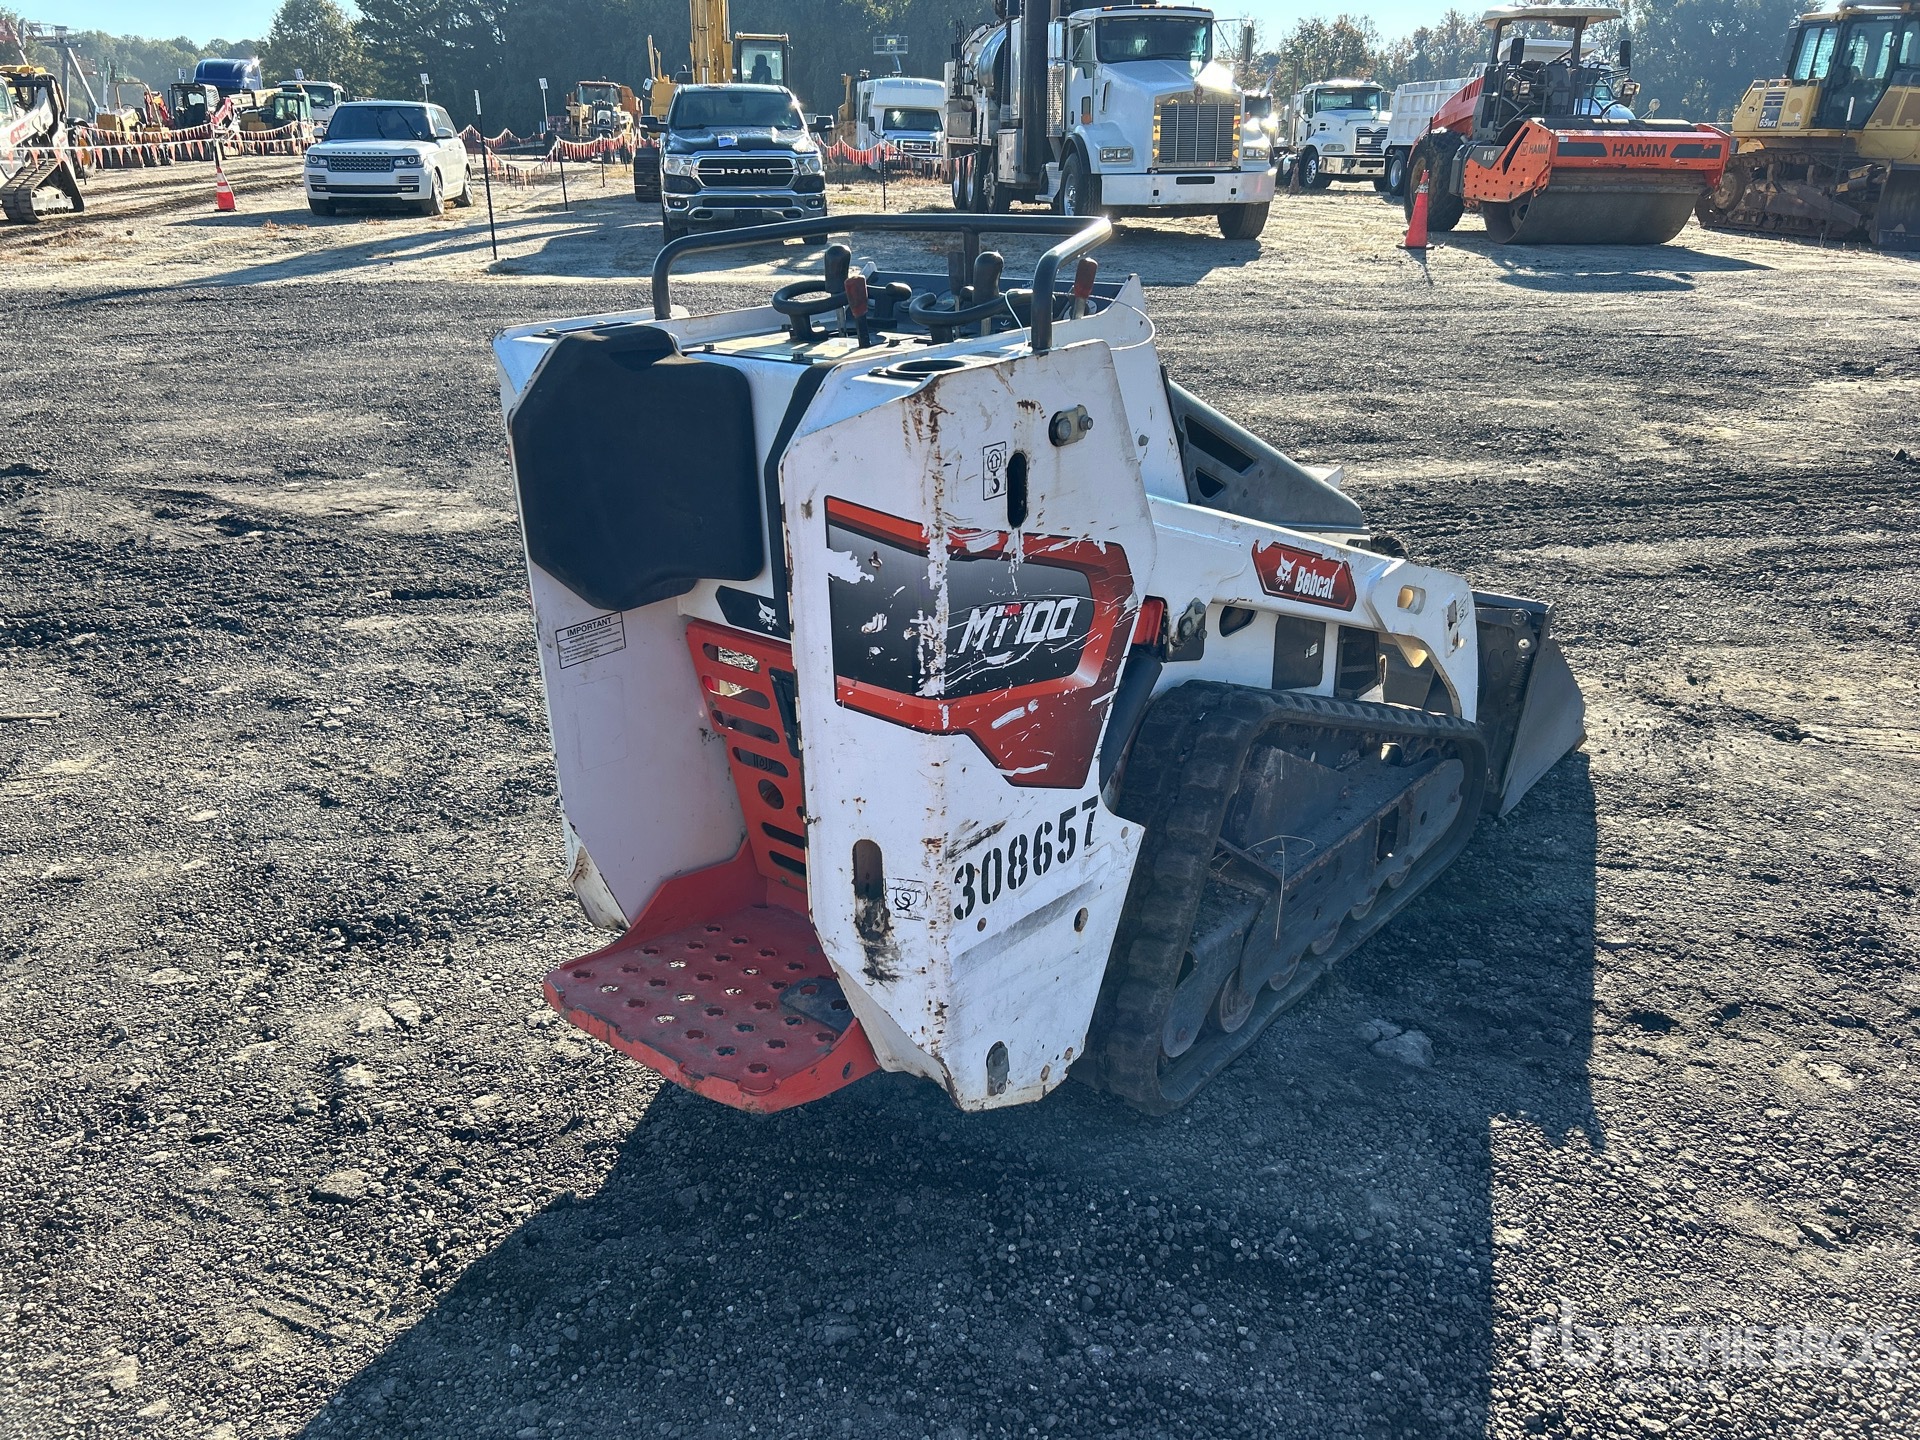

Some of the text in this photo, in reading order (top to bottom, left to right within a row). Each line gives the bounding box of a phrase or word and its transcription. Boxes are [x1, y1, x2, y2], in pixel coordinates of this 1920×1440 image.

[1529, 143, 1549, 155] HAMM
[1612, 143, 1667, 158] HAMM
[1294, 566, 1336, 600] Bobcat
[567, 617, 612, 637] IMPORTANT
[957, 598, 1081, 654] MT100
[952, 795, 1099, 921] 308657
